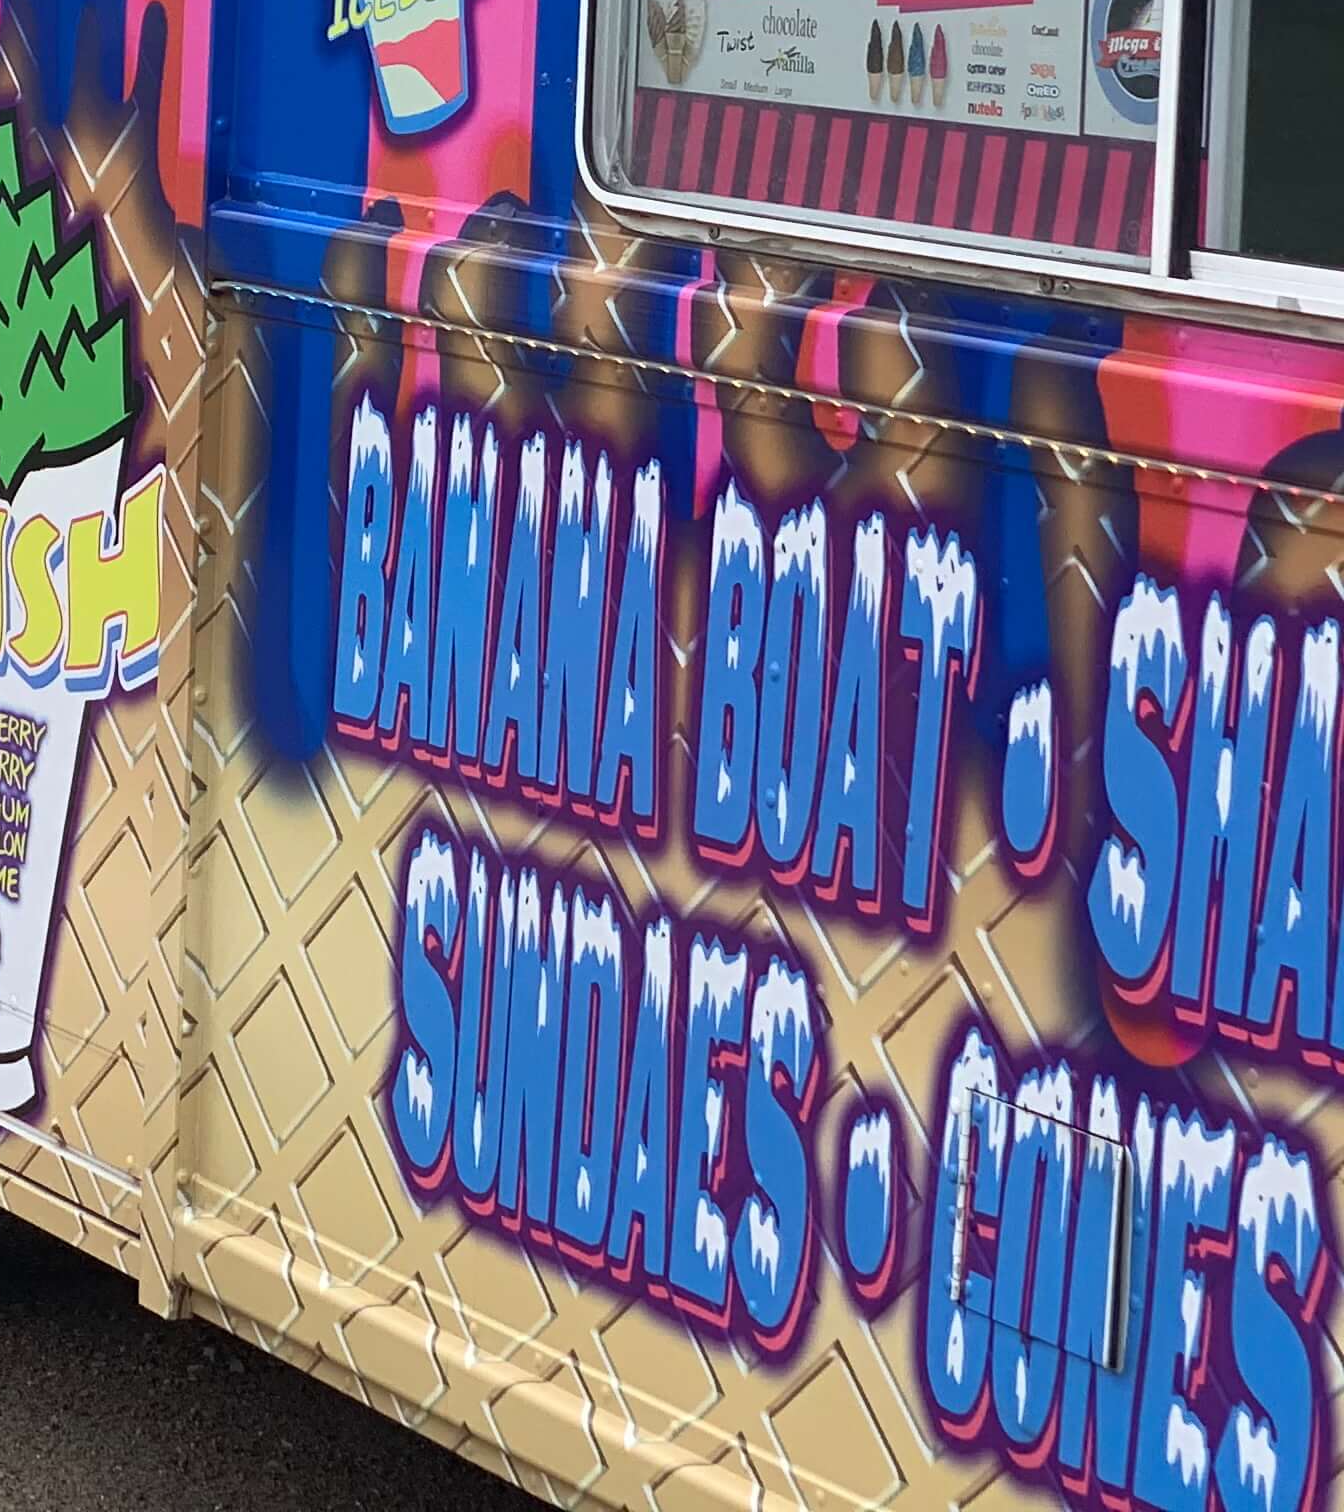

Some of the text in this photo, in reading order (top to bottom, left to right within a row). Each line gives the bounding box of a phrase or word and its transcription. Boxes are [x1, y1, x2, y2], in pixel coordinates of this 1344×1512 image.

[762, 5, 818, 39] chocolate
[716, 30, 755, 53] Twist
[775, 55, 815, 74] vanilla
[1027, 82, 1060, 99] OREO
[333, 391, 1344, 1073] BANANA BOAT SHA
[393, 827, 1332, 1512] SUNDAES CONES
